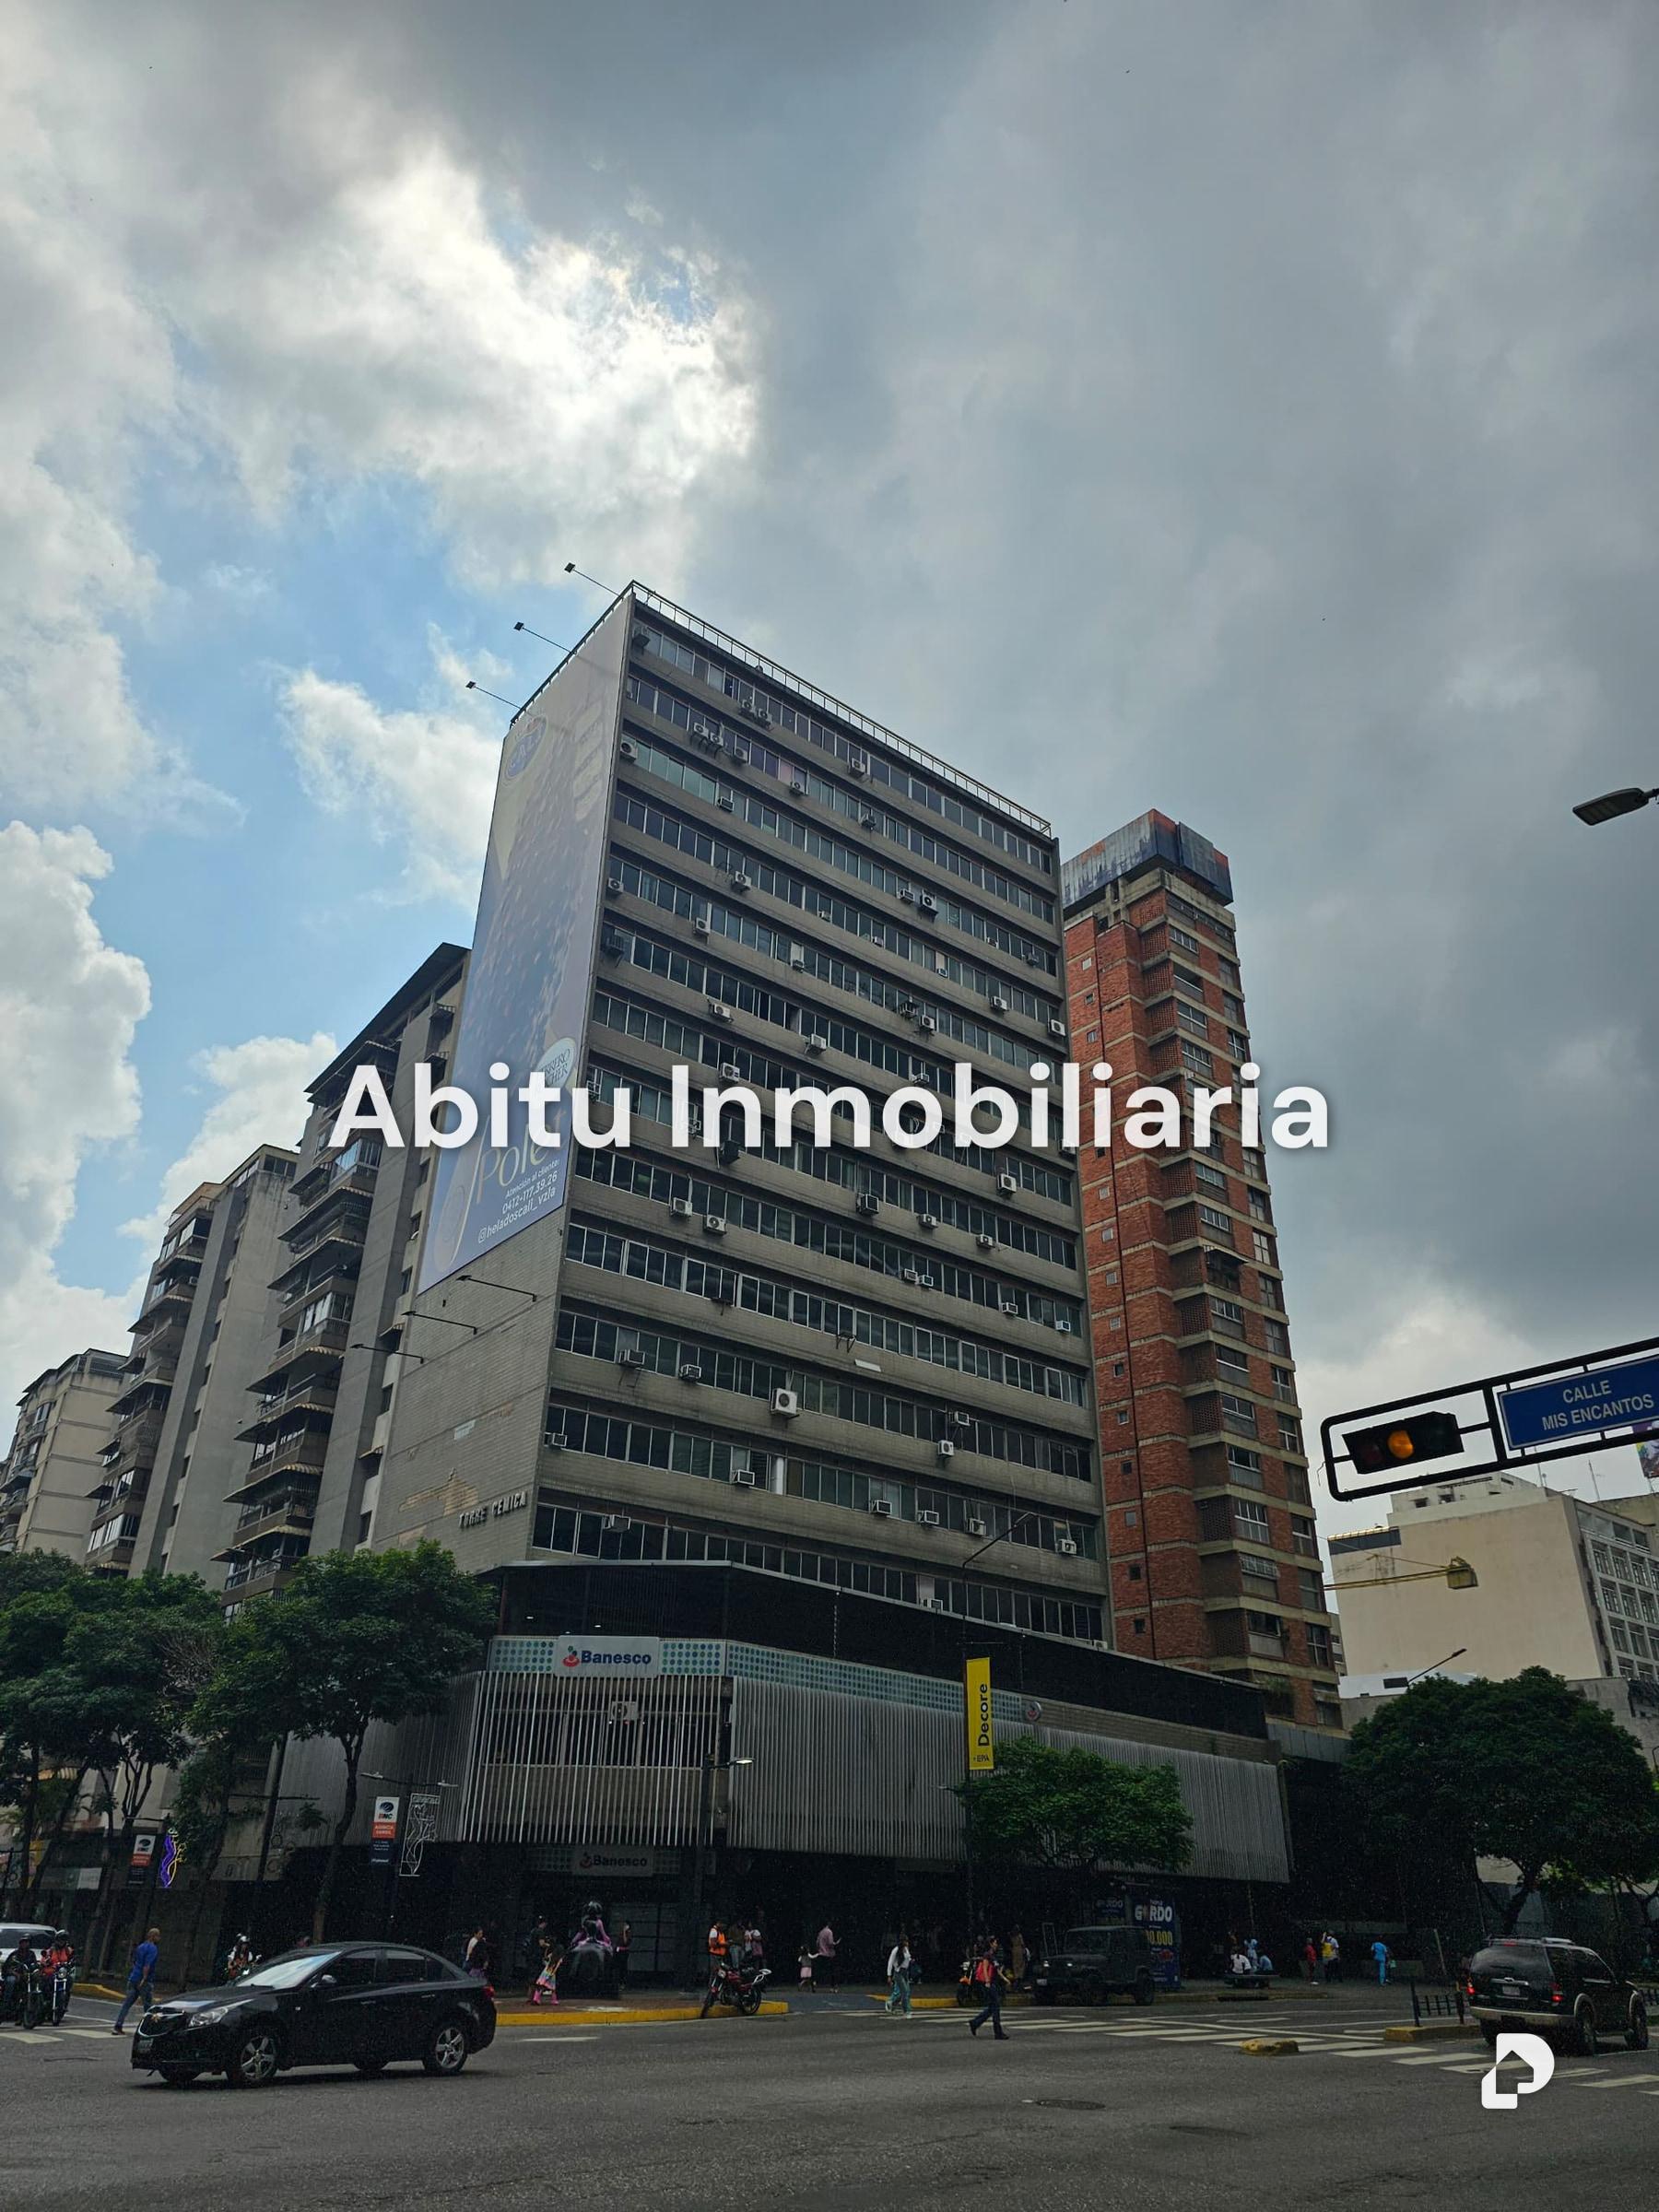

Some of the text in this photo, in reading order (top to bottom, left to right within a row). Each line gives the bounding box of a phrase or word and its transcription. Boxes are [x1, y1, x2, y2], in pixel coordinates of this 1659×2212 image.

[1562, 1380, 1612, 1404] CALLE
[1541, 1394, 1655, 1430] MIS ENCANTOS
[459, 1506, 488, 1528] TORRE
[580, 1649, 653, 1665] Banesco
[977, 1683, 991, 1747] Decore
[593, 1853, 649, 1867] Banesco
